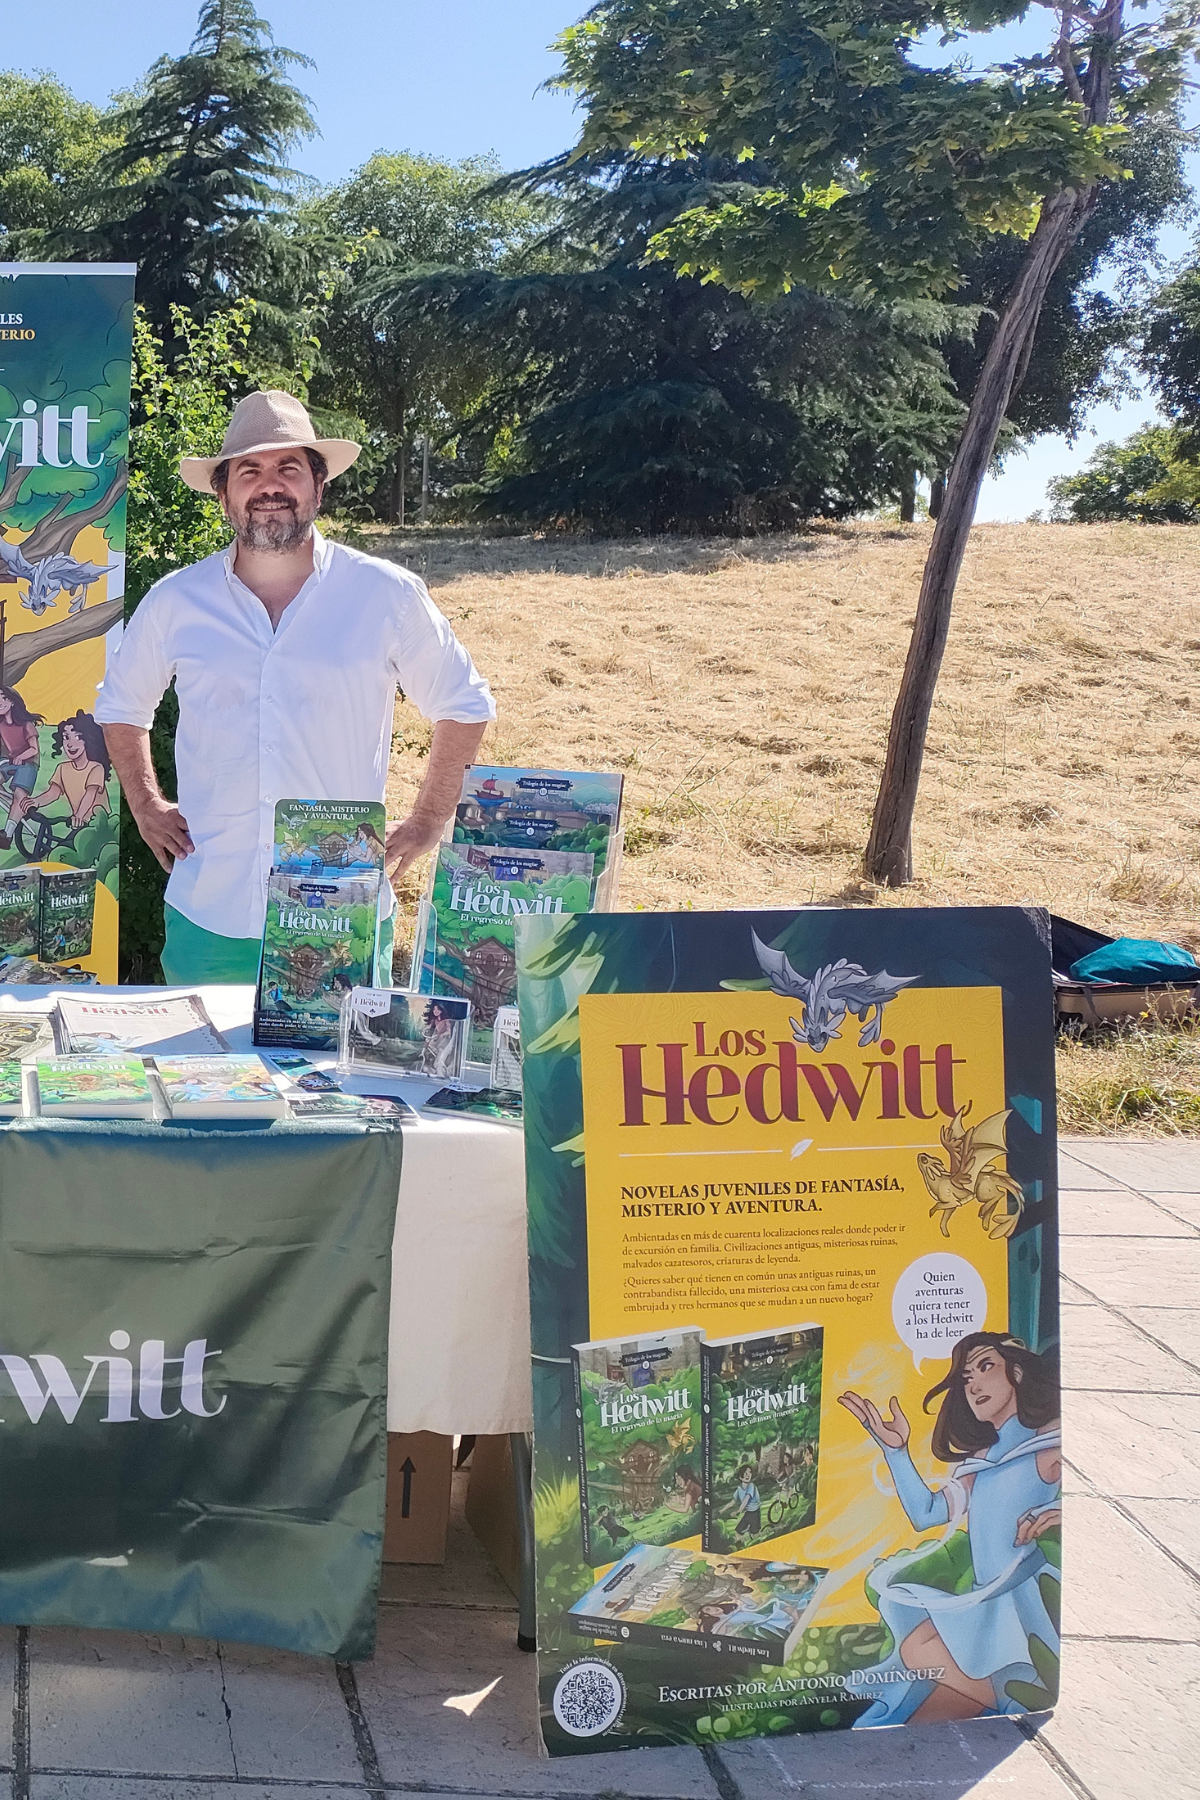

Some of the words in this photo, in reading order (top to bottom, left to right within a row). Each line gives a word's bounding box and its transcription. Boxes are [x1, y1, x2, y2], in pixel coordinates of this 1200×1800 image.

[289, 805, 330, 813] FANTASÍA,
[477, 882, 500, 893] Los
[449, 886, 567, 915] Hedwitt
[280, 912, 353, 933] Hedwitt
[693, 1021, 767, 1057] Los
[616, 1039, 972, 1127] Hedwitt
[621, 1184, 699, 1199] NOVELAS
[703, 1182, 791, 1200] JUVENILES
[795, 1181, 817, 1194] DE
[821, 1175, 905, 1193] FANTASÍA,
[622, 1199, 705, 1217] MISTERIO
[710, 1202, 720, 1215] Y
[726, 1199, 822, 1214] AVENTURA.
[622, 1232, 679, 1242] Ambientadas
[693, 1231, 710, 1240] más
[712, 1230, 722, 1239] de
[724, 1231, 761, 1239] cuarenta
[763, 1227, 820, 1238] localizaciones
[821, 1225, 844, 1235] reales
[845, 1224, 871, 1234] donde
[873, 1223, 897, 1236] poder
[899, 1223, 906, 1232] ir
[622, 1246, 632, 1256] de
[634, 1245, 675, 1255] excursión
[690, 1243, 722, 1253] familia.
[724, 1242, 783, 1252] Civilizaciones
[784, 1240, 821, 1252] antiguas,
[823, 1238, 869, 1248] misteriosas
[870, 1237, 898, 1246] ruinas,
[623, 1259, 663, 1269] malvados
[664, 1259, 714, 1267] cazatesoros,
[716, 1256, 753, 1265] criaturas
[755, 1254, 765, 1264] de
[767, 1253, 801, 1266] leyenda.
[623, 1276, 661, 1288] ¿Quieres
[662, 1274, 685, 1284] saber
[687, 1274, 703, 1287] qué
[705, 1274, 732, 1282] tienen
[746, 1271, 775, 1281] común
[799, 1270, 834, 1281] antiguas
[835, 1268, 863, 1277] ruinas,
[923, 1272, 955, 1285] Quien
[623, 1288, 687, 1299] contrabandista
[689, 1286, 728, 1296] fallecido,
[747, 1285, 790, 1294] misteriosa
[827, 1281, 848, 1290] fama
[849, 1280, 859, 1289] de
[915, 1287, 963, 1297] aventuras
[624, 1301, 669, 1314] embrujada
[671, 1304, 676, 1314] y
[696, 1300, 739, 1310] hermanos
[741, 1300, 756, 1310] que
[768, 1296, 798, 1306] mudan
[819, 1296, 845, 1304] nuevo
[846, 1292, 874, 1305] hogar?
[909, 1301, 941, 1315] quiera
[944, 1301, 970, 1309] tener
[914, 1314, 927, 1325] los
[931, 1313, 973, 1324] Hedwitt
[917, 1329, 928, 1339] ha
[931, 1328, 942, 1338] de
[946, 1327, 964, 1337] leer
[620, 1393, 639, 1408] Los
[727, 1382, 808, 1422] Hedwitt
[746, 1387, 763, 1400] Los
[600, 1387, 692, 1428] Hedwitt
[658, 1684, 732, 1702] ESCRITAS
[737, 1682, 767, 1696] POR
[771, 1674, 846, 1693] ANTONIO
[851, 1666, 946, 1686] DOMÍNGUEZ
[722, 1701, 778, 1713] ILUSTRADAS
[780, 1699, 798, 1709] POR
[800, 1694, 838, 1706] ANYELA
[840, 1690, 884, 1702] RAMÍREZ
